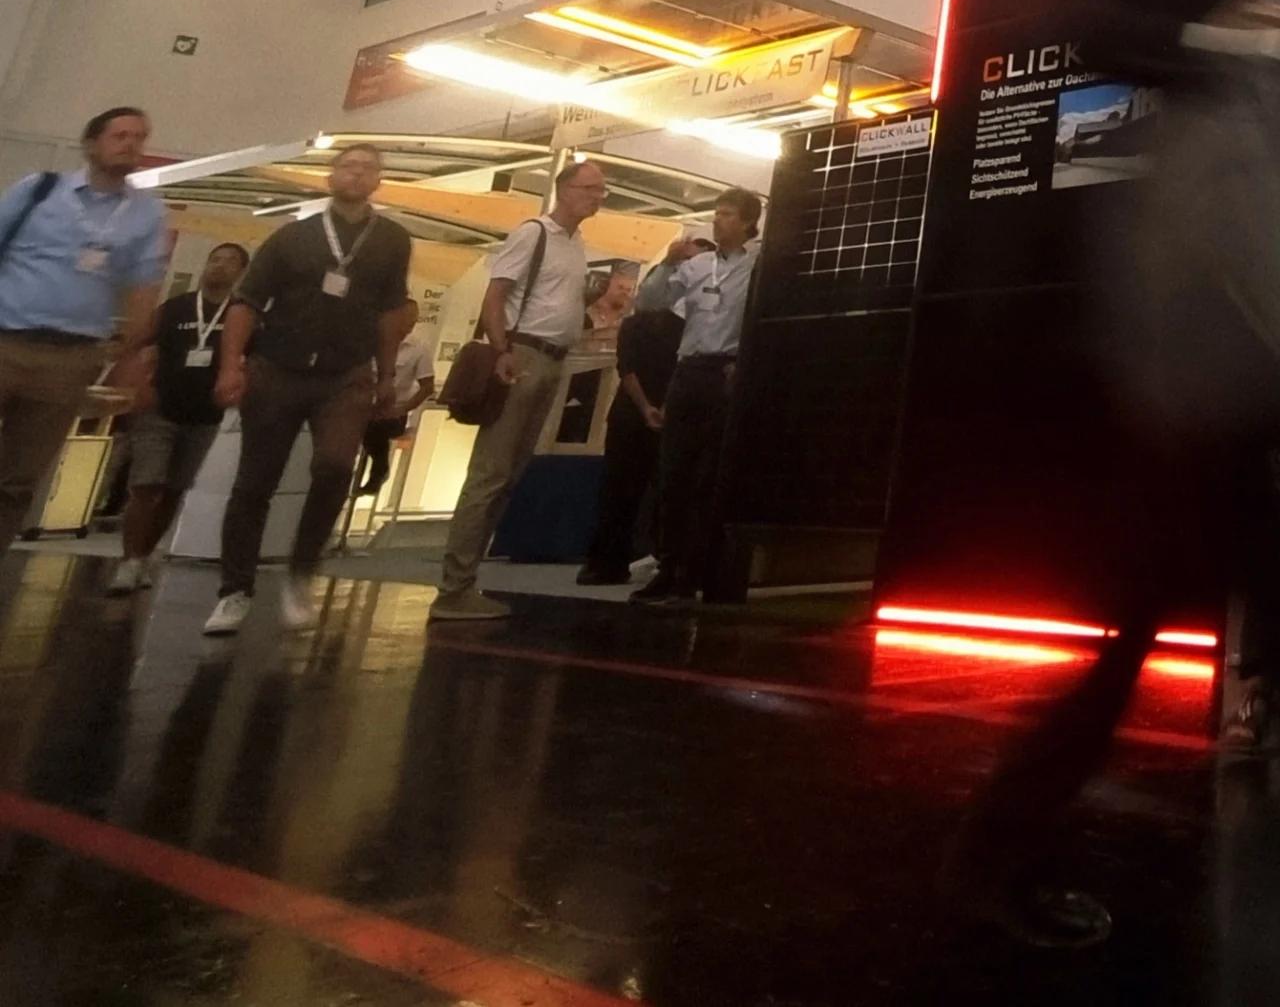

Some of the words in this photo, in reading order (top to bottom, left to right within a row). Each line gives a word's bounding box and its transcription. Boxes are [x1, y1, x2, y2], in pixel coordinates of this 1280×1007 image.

[676, 48, 825, 97] LICKAST
[983, 41, 1085, 83] CLICK
[980, 88, 996, 101] Die
[996, 79, 1047, 99] Alternative
[1047, 77, 1064, 89] zur
